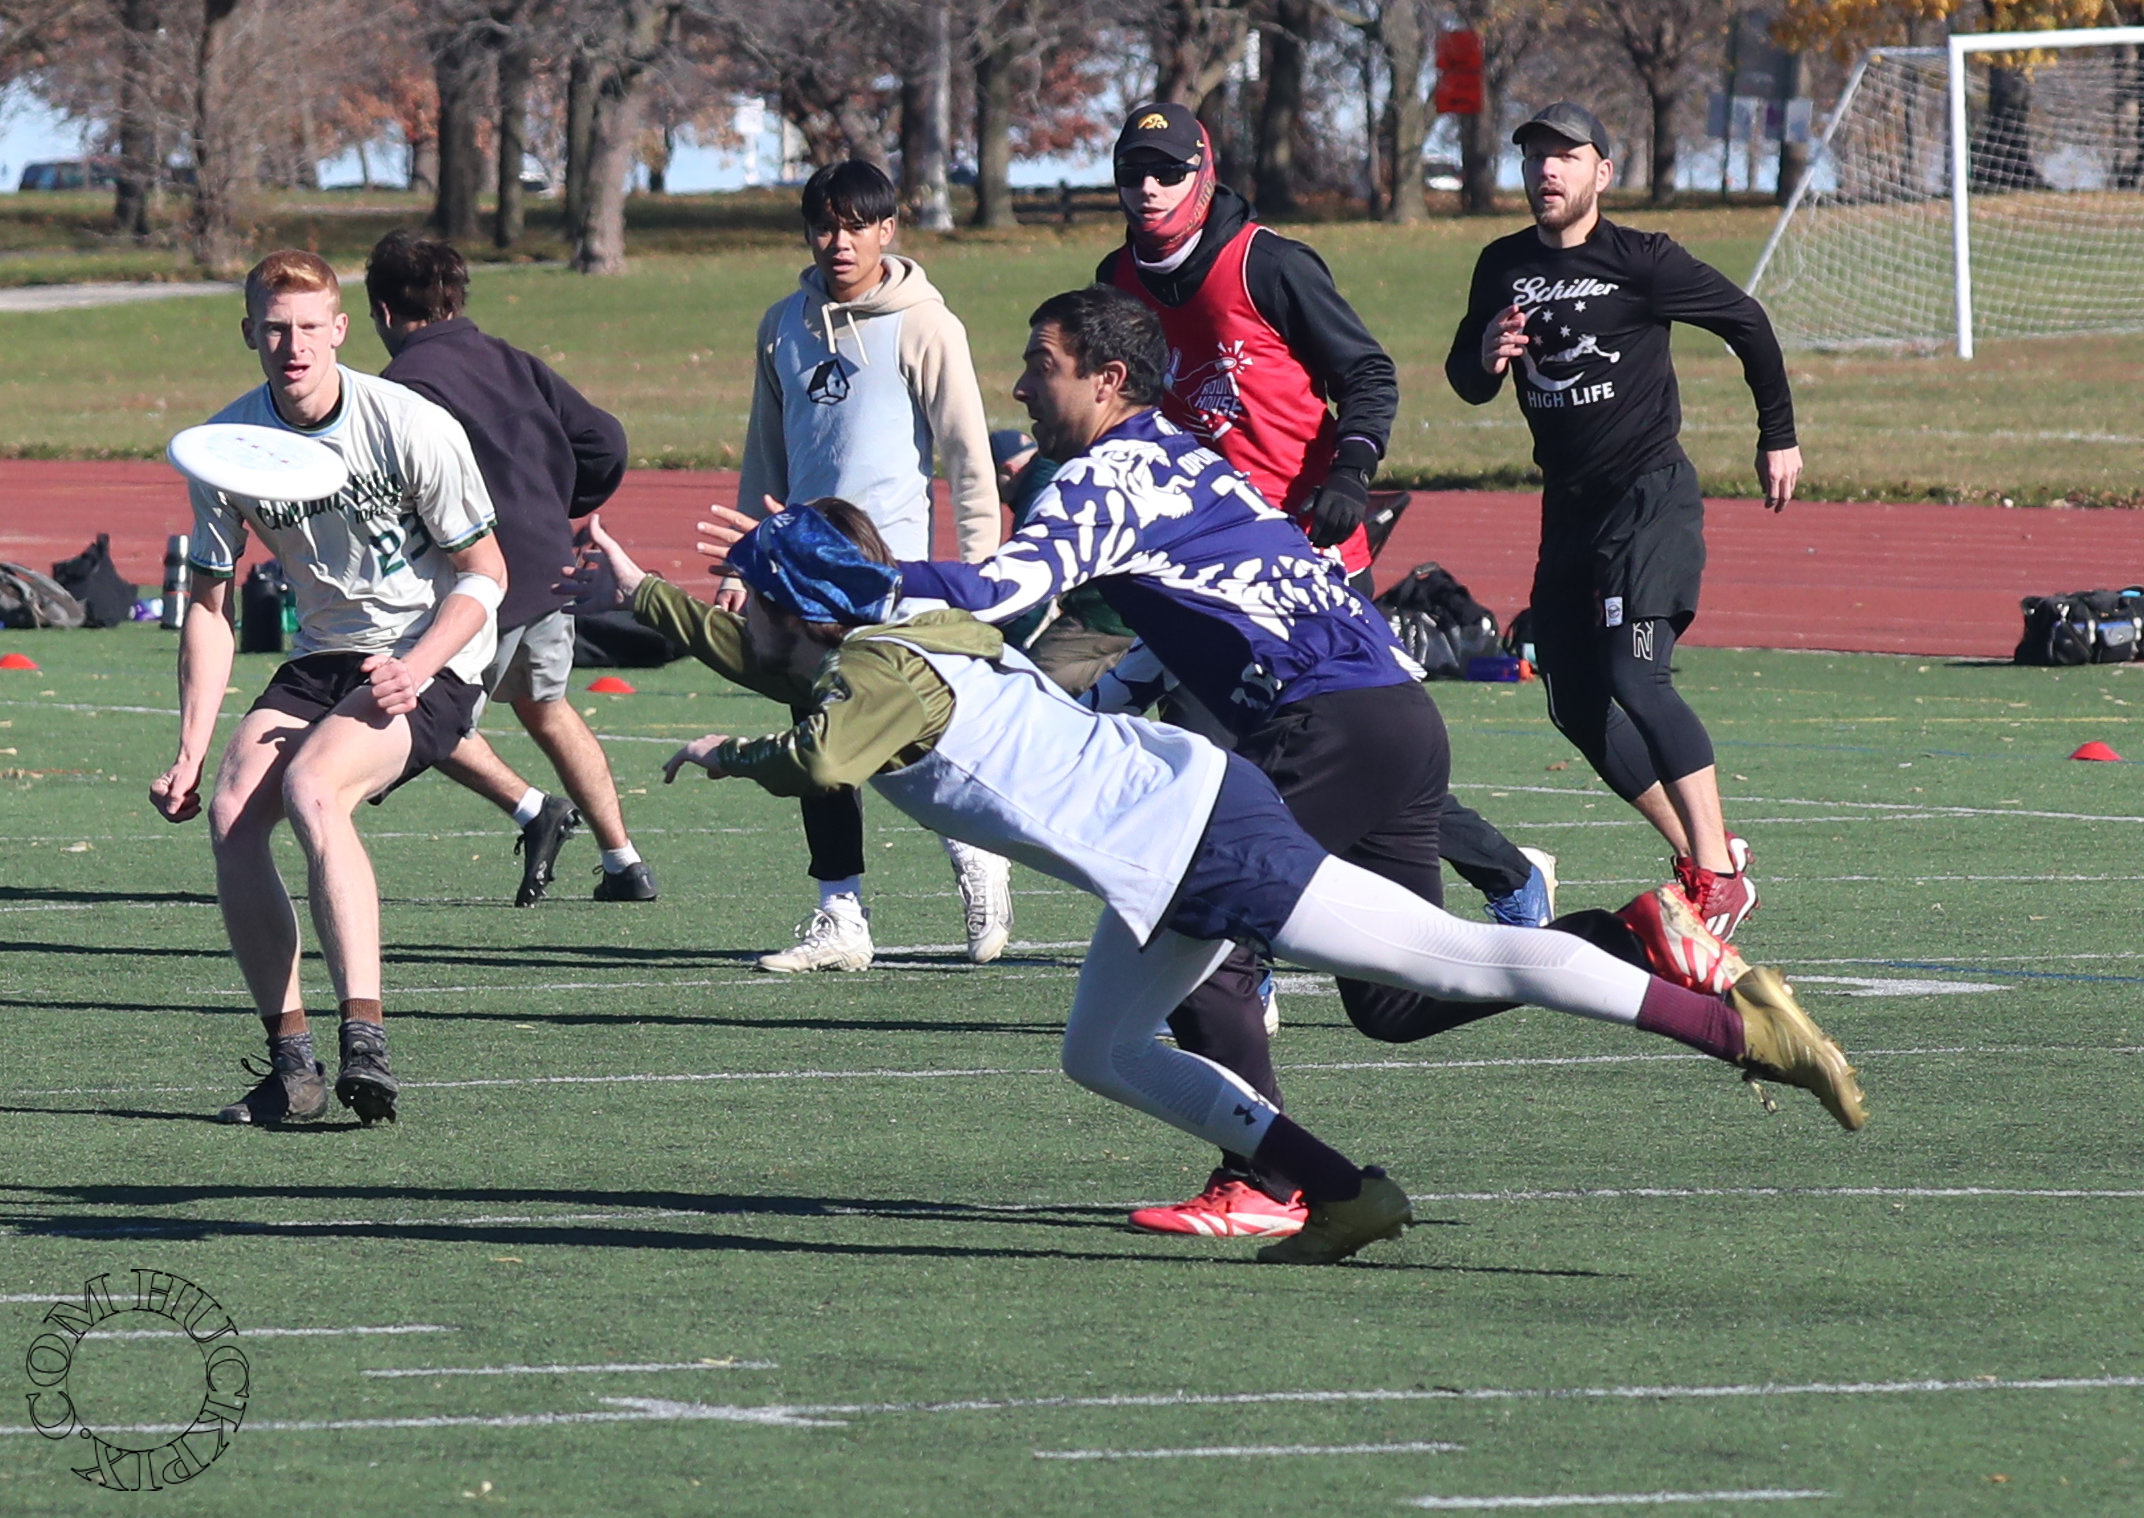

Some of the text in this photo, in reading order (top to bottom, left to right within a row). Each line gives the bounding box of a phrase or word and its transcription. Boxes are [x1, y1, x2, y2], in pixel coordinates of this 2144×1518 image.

[1512, 276, 1620, 306] Schiller
[1194, 395, 1242, 411] HOUSE
[1527, 381, 1615, 408] HIGH LIFE
[368, 509, 433, 577] 23
